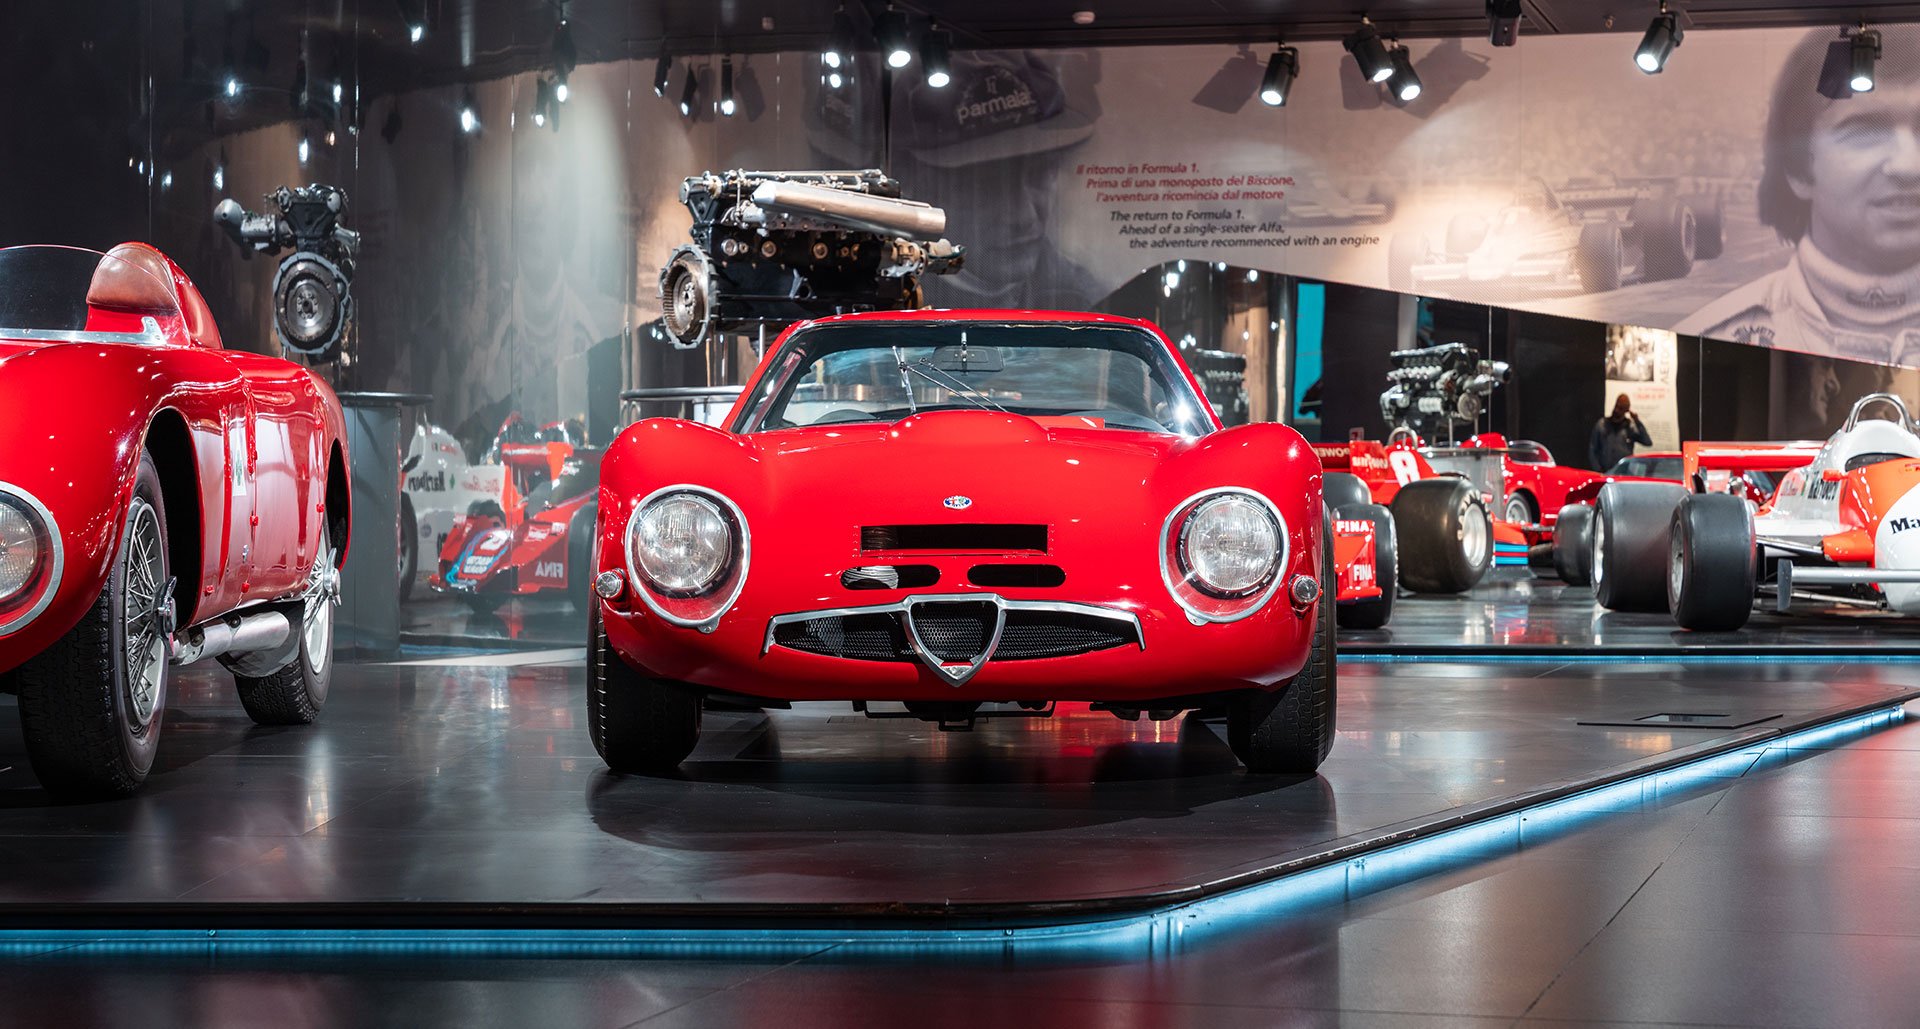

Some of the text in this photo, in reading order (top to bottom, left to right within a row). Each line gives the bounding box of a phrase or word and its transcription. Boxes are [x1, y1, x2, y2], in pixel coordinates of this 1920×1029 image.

[1086, 163, 1124, 175] ritorno
[1127, 163, 1139, 174] in
[1141, 162, 1187, 174] Formula
[1190, 162, 1200, 174] 1.
[1086, 175, 1296, 190] Prima di una monoposto del Biscione,
[1096, 189, 1284, 202] l'avventura ricomincia dal motore
[1110, 209, 1245, 221] The return to Formula 1.
[1119, 221, 1285, 236] Ahead of a single-seater Alfa,
[1129, 234, 1380, 249] the adventure recommenced with an engine
[1336, 520, 1370, 532] FINA
[1353, 564, 1373, 581] FINA
